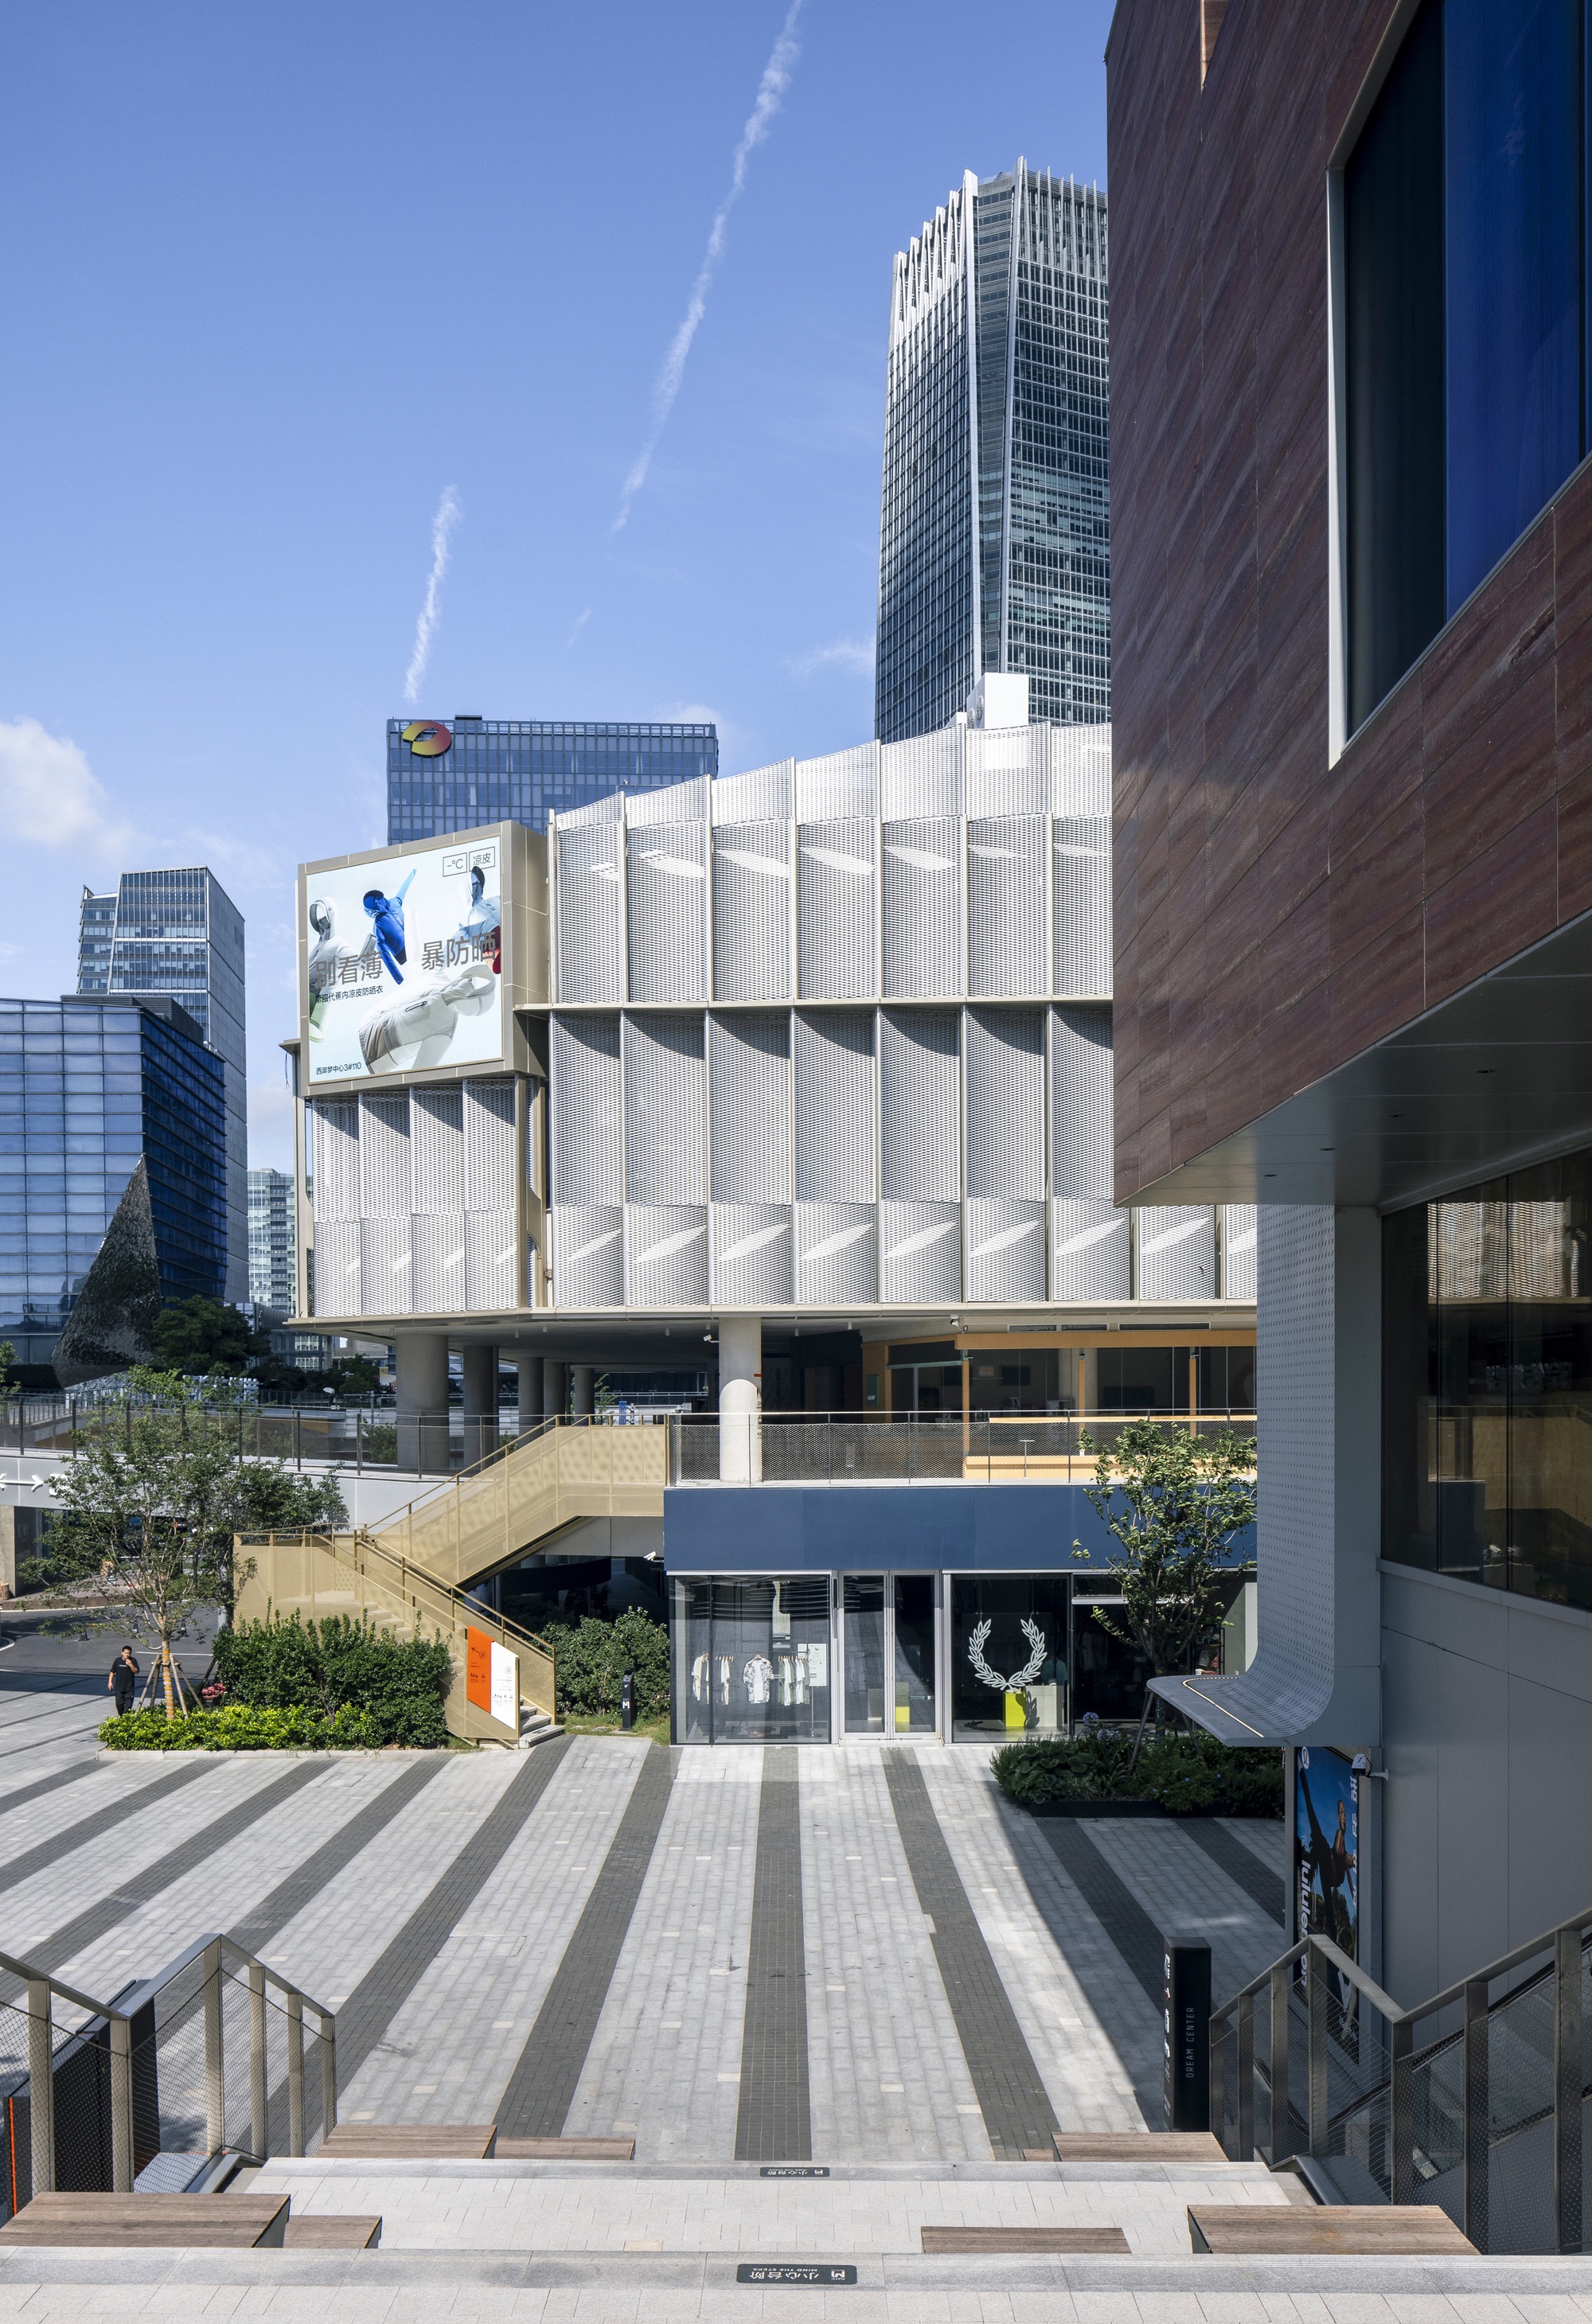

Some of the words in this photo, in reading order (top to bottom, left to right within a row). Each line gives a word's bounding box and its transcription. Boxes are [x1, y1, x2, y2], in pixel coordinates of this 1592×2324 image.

[473, 852, 491, 866] 凉皮
[314, 949, 384, 989] 别看薄
[421, 930, 497, 971] 暴防晒
[1186, 2007, 1195, 2042] CENTER
[1186, 2049, 1195, 2078] DREAM
[749, 2271, 819, 2280] 小心台阶
